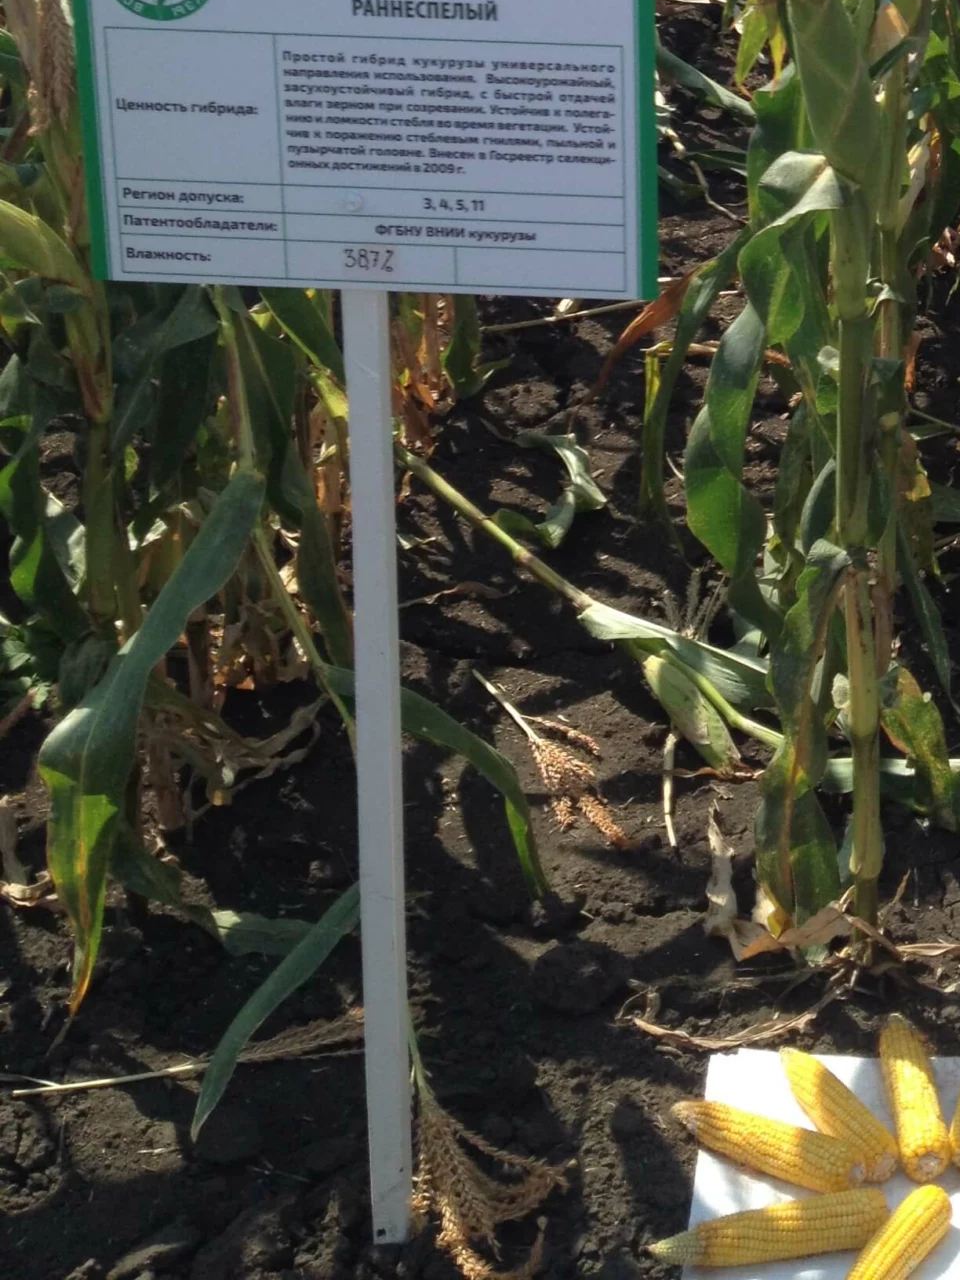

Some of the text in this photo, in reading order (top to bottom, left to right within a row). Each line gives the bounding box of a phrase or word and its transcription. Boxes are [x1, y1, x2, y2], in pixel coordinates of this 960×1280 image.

[282, 51, 616, 73] Простой гибрид кукурузы универсального
[283, 69, 615, 89] направления использования. Высокоурожайный,
[283, 84, 414, 96] засухоустойчивый
[420, 88, 475, 99] гибрид,
[493, 90, 553, 102] быстрой
[558, 93, 615, 103] отдачей
[116, 98, 258, 116] Ценность гибрида:
[284, 99, 323, 108] влаги
[326, 100, 375, 111] зерном
[378, 102, 403, 112] при
[406, 104, 486, 114] созревании.
[490, 105, 550, 116] Устойчив
[564, 110, 615, 119] полега-
[285, 115, 313, 123] нию
[325, 116, 387, 126] ломкости
[390, 117, 434, 127] стебля
[437, 120, 452, 128] во
[454, 121, 495, 131] время
[497, 122, 568, 133] вегетации.
[572, 123, 615, 133] Устой-
[285, 130, 310, 138] чив
[325, 131, 402, 141] поражению
[406, 133, 479, 144] стеблевым
[482, 137, 543, 147] гнилями,
[546, 139, 604, 149] пыльной
[287, 145, 366, 155] пузырчатой
[369, 148, 425, 157] головне.
[428, 148, 475, 159] Внесен
[489, 151, 554, 164] Госреестр
[557, 155, 616, 165] селекци-
[287, 160, 330, 168] онных
[332, 162, 411, 172] достижений
[422, 163, 455, 174] 2009
[456, 166, 466, 174] г.
[123, 188, 244, 204] Регион допуска:
[423, 198, 485, 212] 3, 4, 5, 11
[124, 215, 278, 231] Патентообладатели:
[375, 225, 536, 242] ФГБНУ ВНИИ кукурузы
[126, 248, 211, 261] Влажность:
